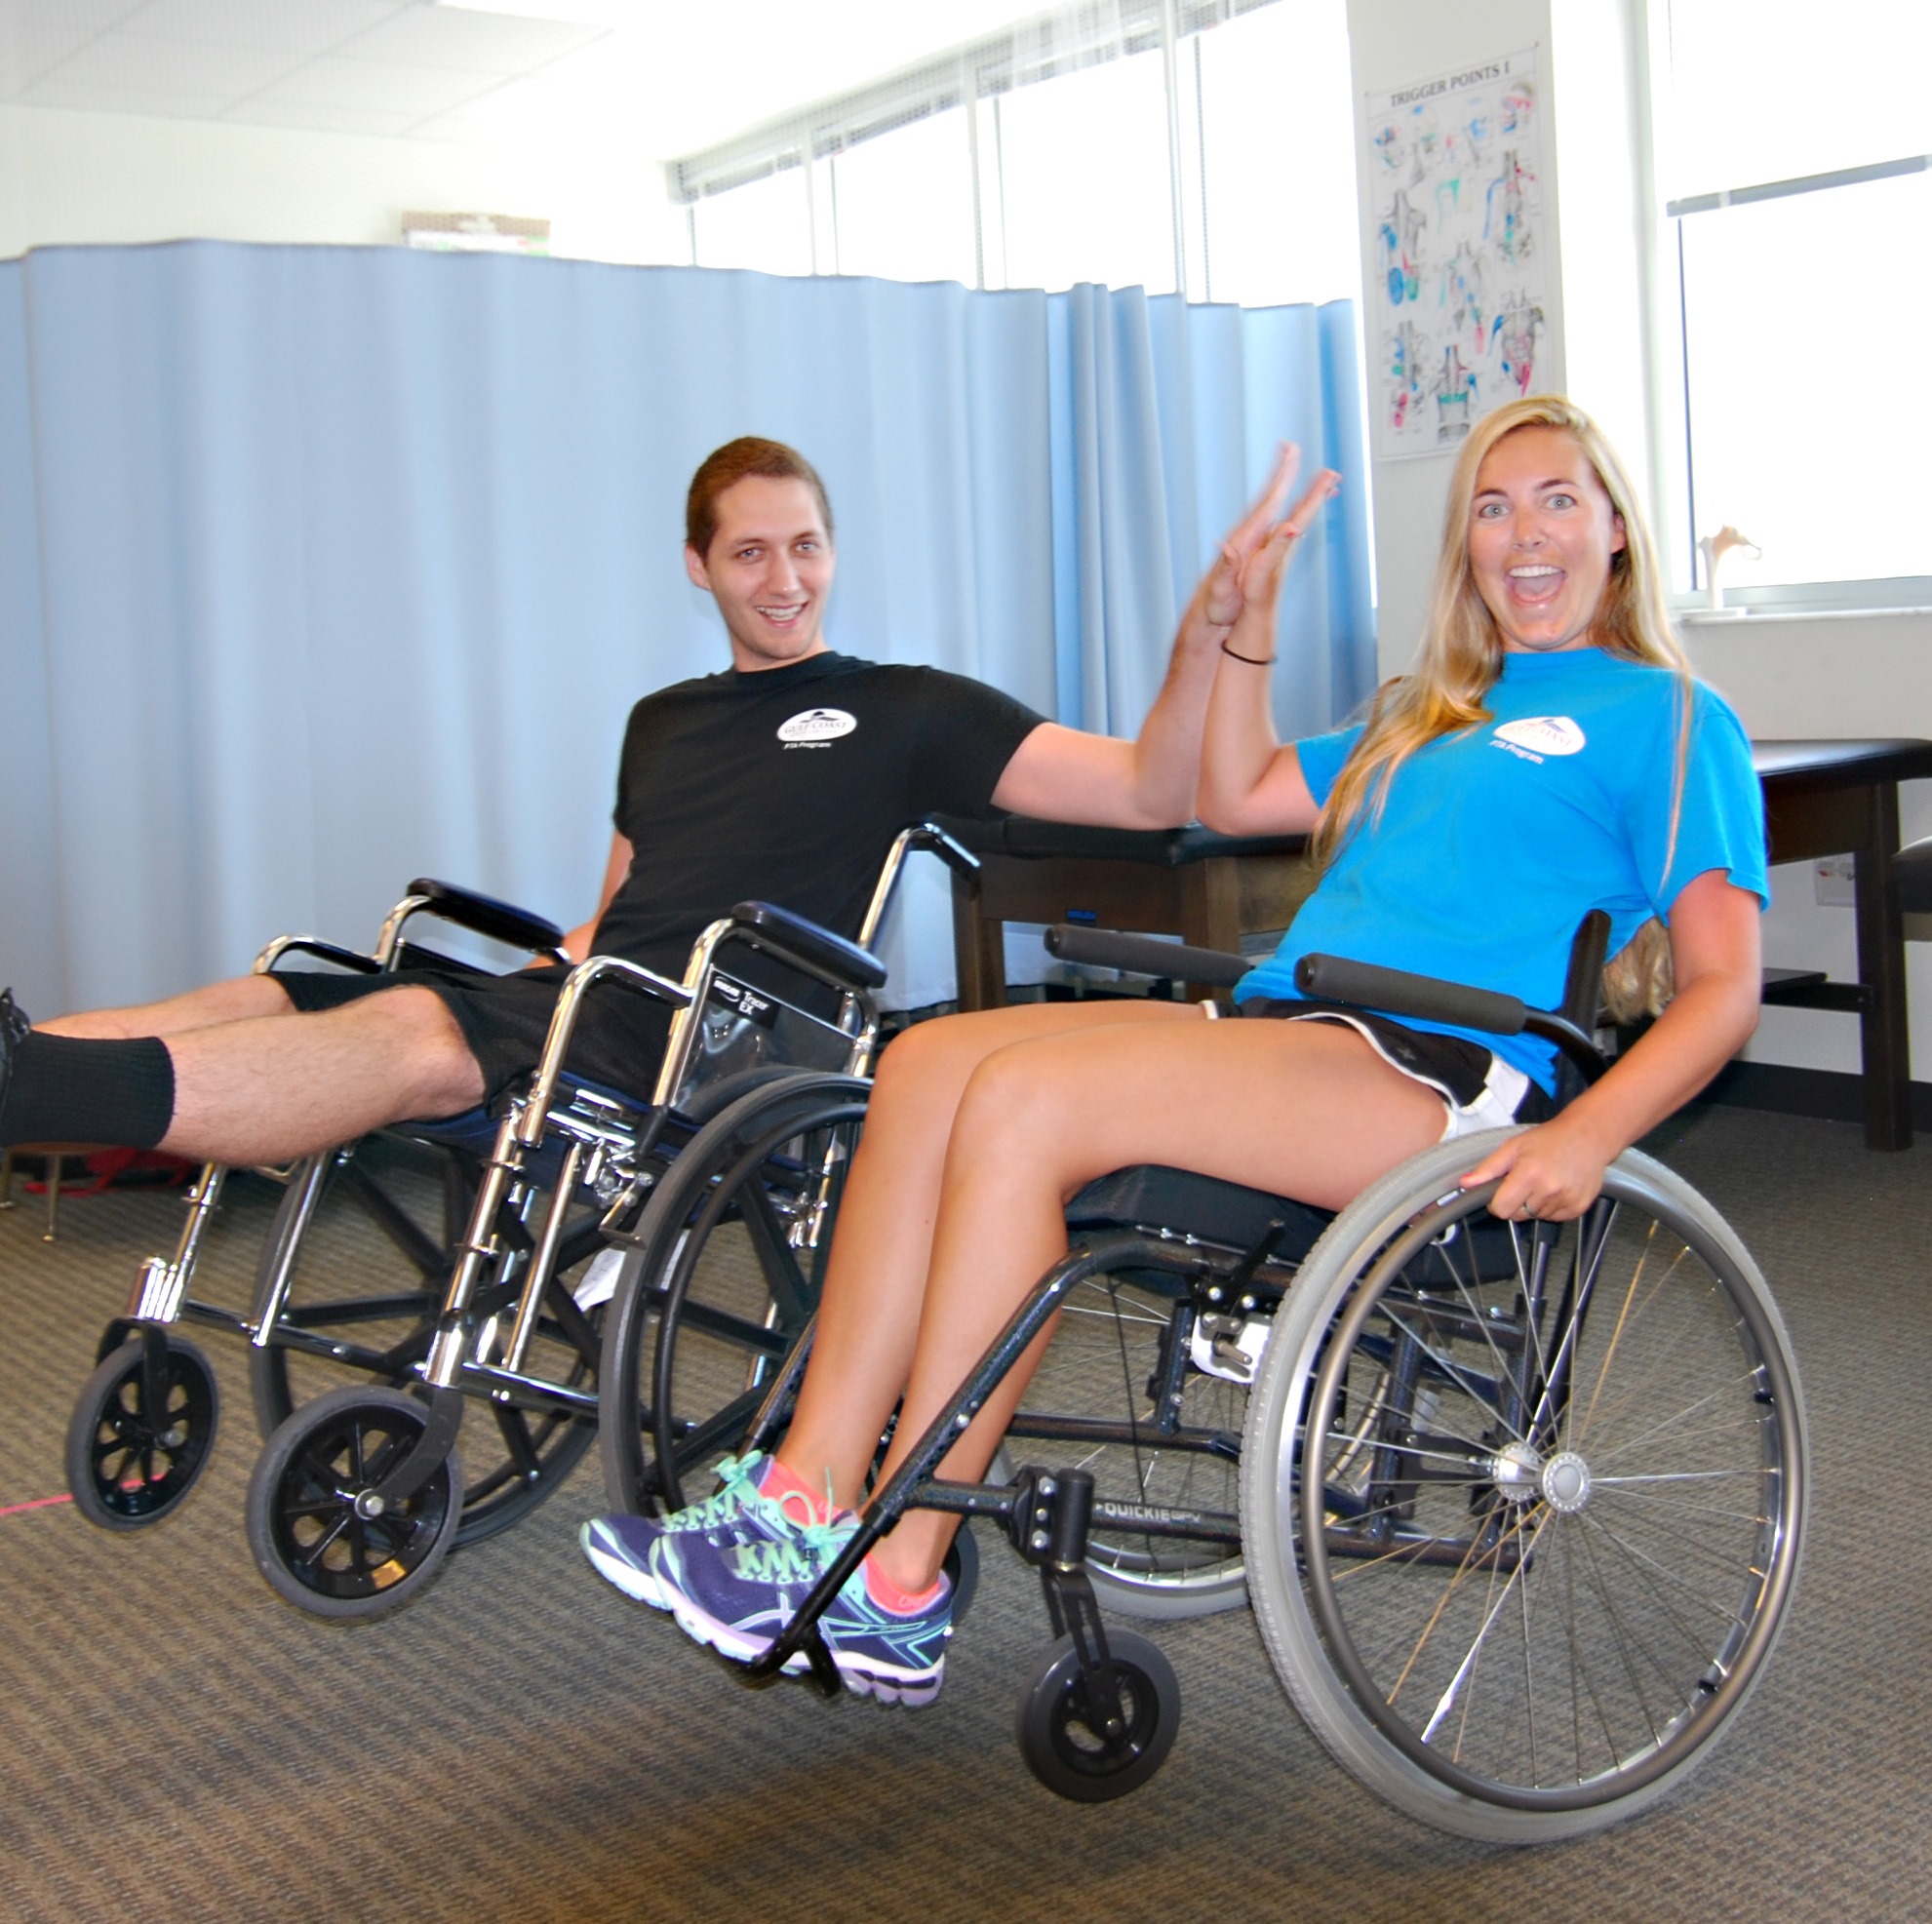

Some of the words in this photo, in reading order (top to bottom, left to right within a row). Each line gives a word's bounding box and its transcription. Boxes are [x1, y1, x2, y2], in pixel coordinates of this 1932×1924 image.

[1391, 80, 1446, 107] TRIGGER
[1450, 63, 1500, 90] POINTS
[1104, 1502, 1171, 1521] QUICKIE
